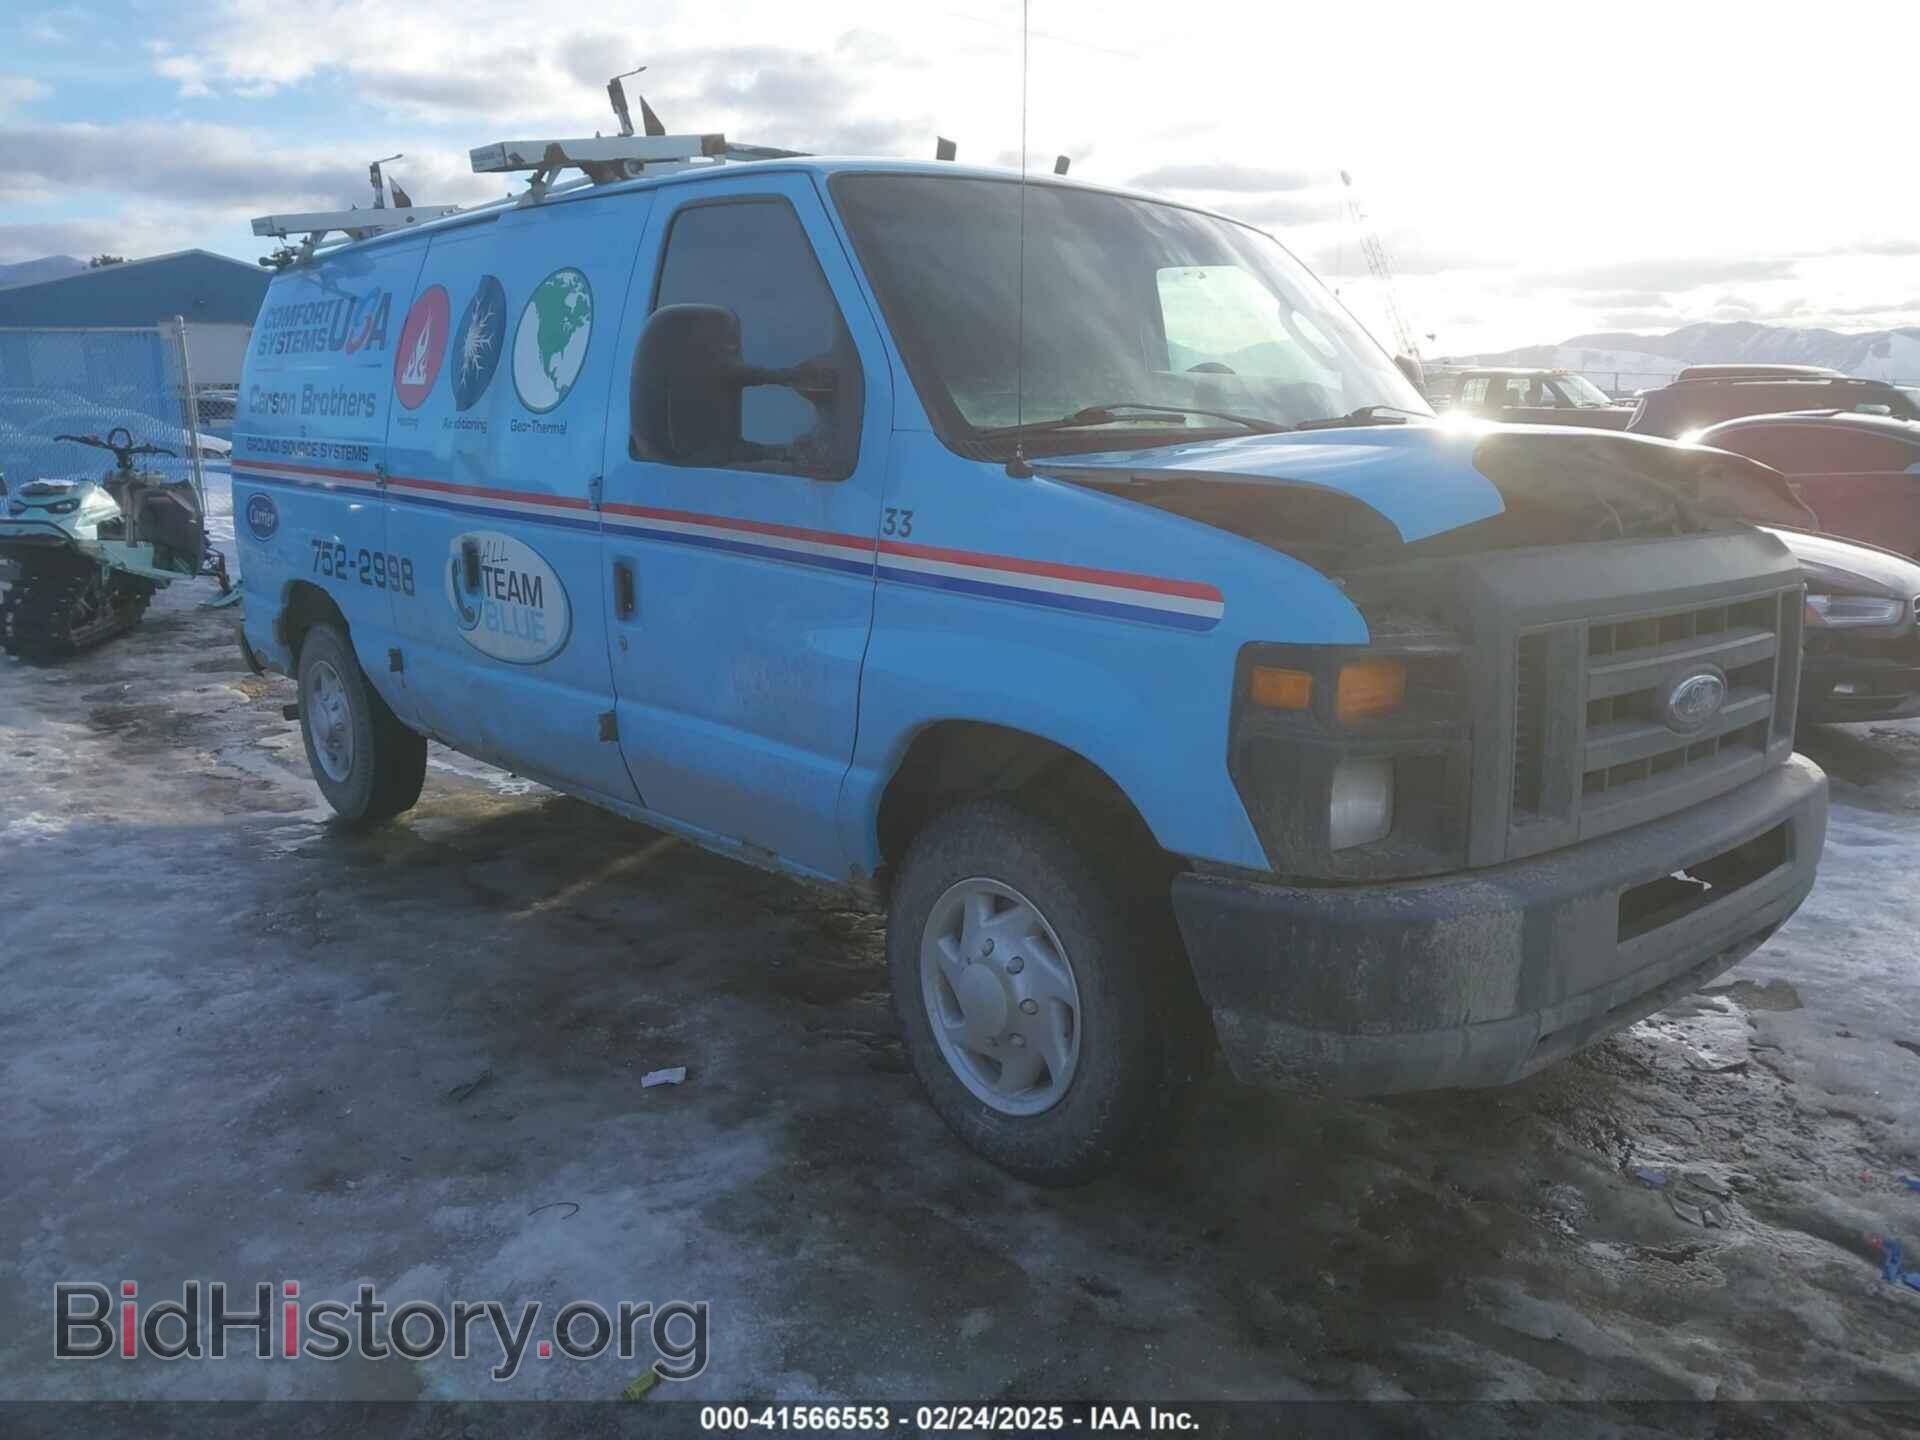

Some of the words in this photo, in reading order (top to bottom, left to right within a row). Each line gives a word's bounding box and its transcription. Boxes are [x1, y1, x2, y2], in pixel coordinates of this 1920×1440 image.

[264, 299, 335, 330] COMFORT
[257, 328, 329, 356] SYSTEMS
[300, 383, 376, 417] Brothers
[510, 418, 568, 434] Geo-Thermal
[319, 442, 369, 463] SYSTEMS
[883, 507, 913, 538] 33
[311, 539, 416, 597] 752-2998
[480, 565, 544, 609] TEAM
[485, 601, 547, 644] BLUE
